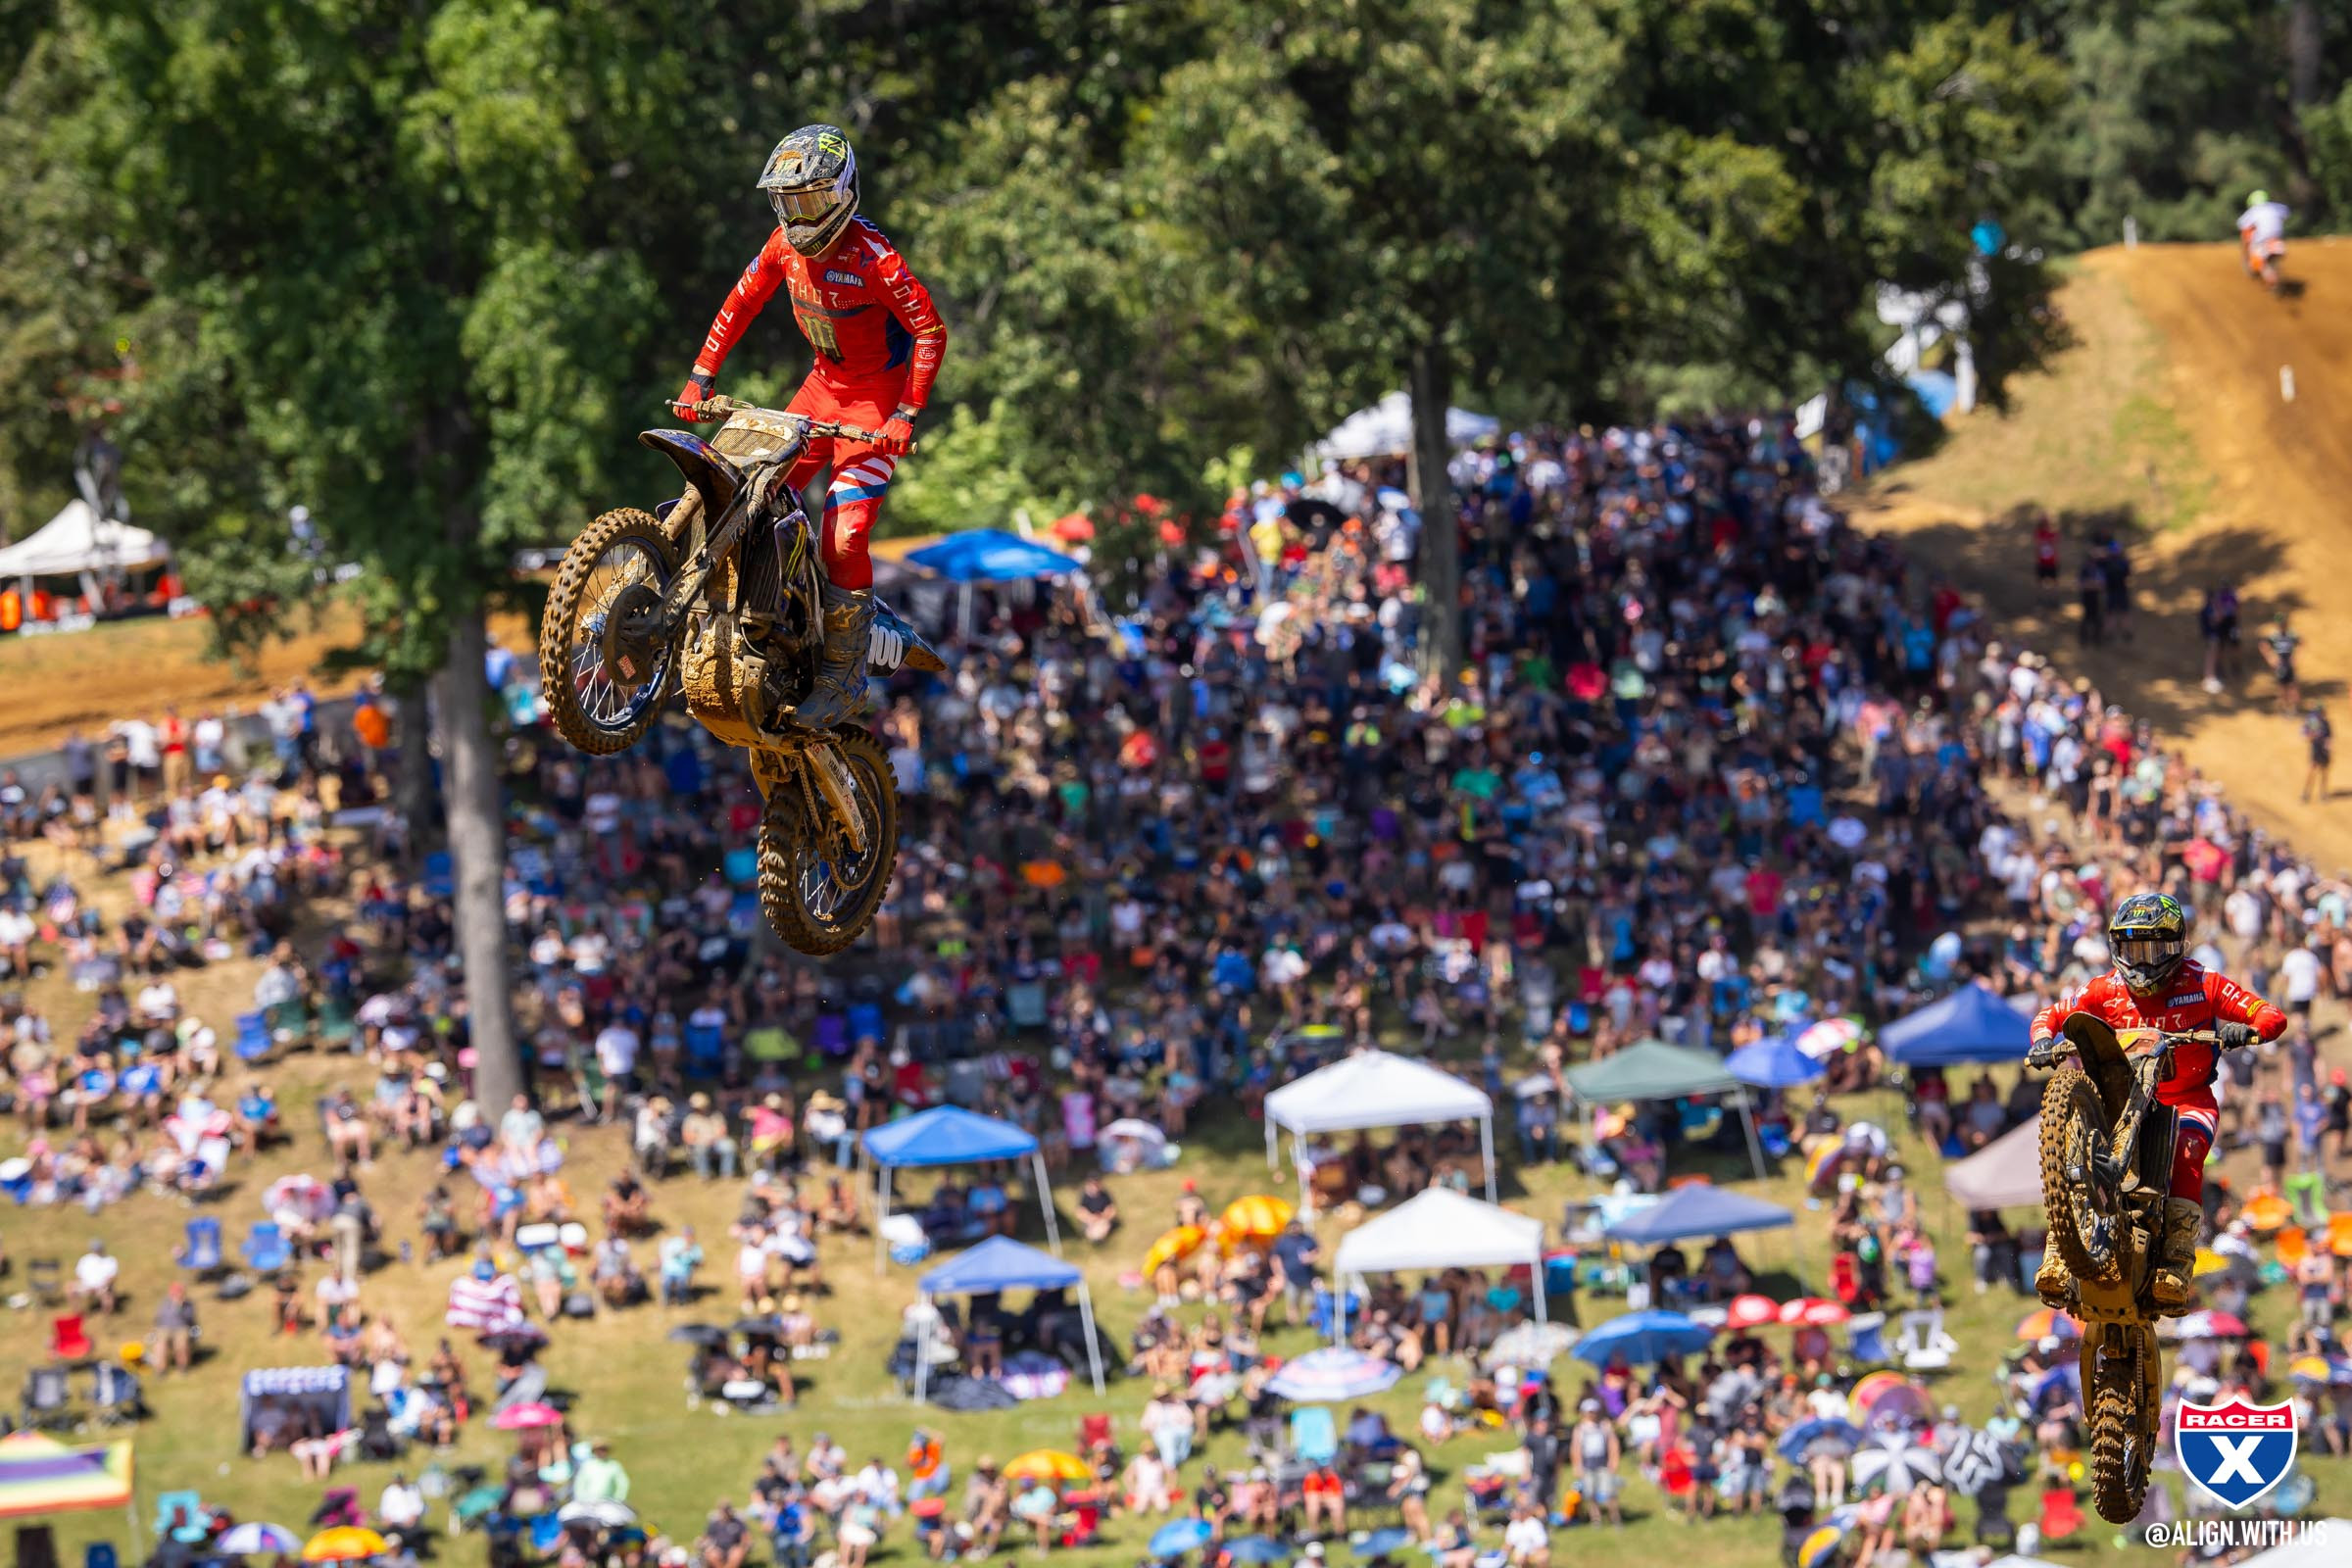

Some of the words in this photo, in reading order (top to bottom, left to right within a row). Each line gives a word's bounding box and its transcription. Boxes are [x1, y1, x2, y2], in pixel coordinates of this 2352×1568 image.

[834, 271, 863, 287] YAMAHA
[788, 277, 840, 309] THOR
[867, 623, 904, 670] 100
[2173, 991, 2205, 1006] YAMAHA
